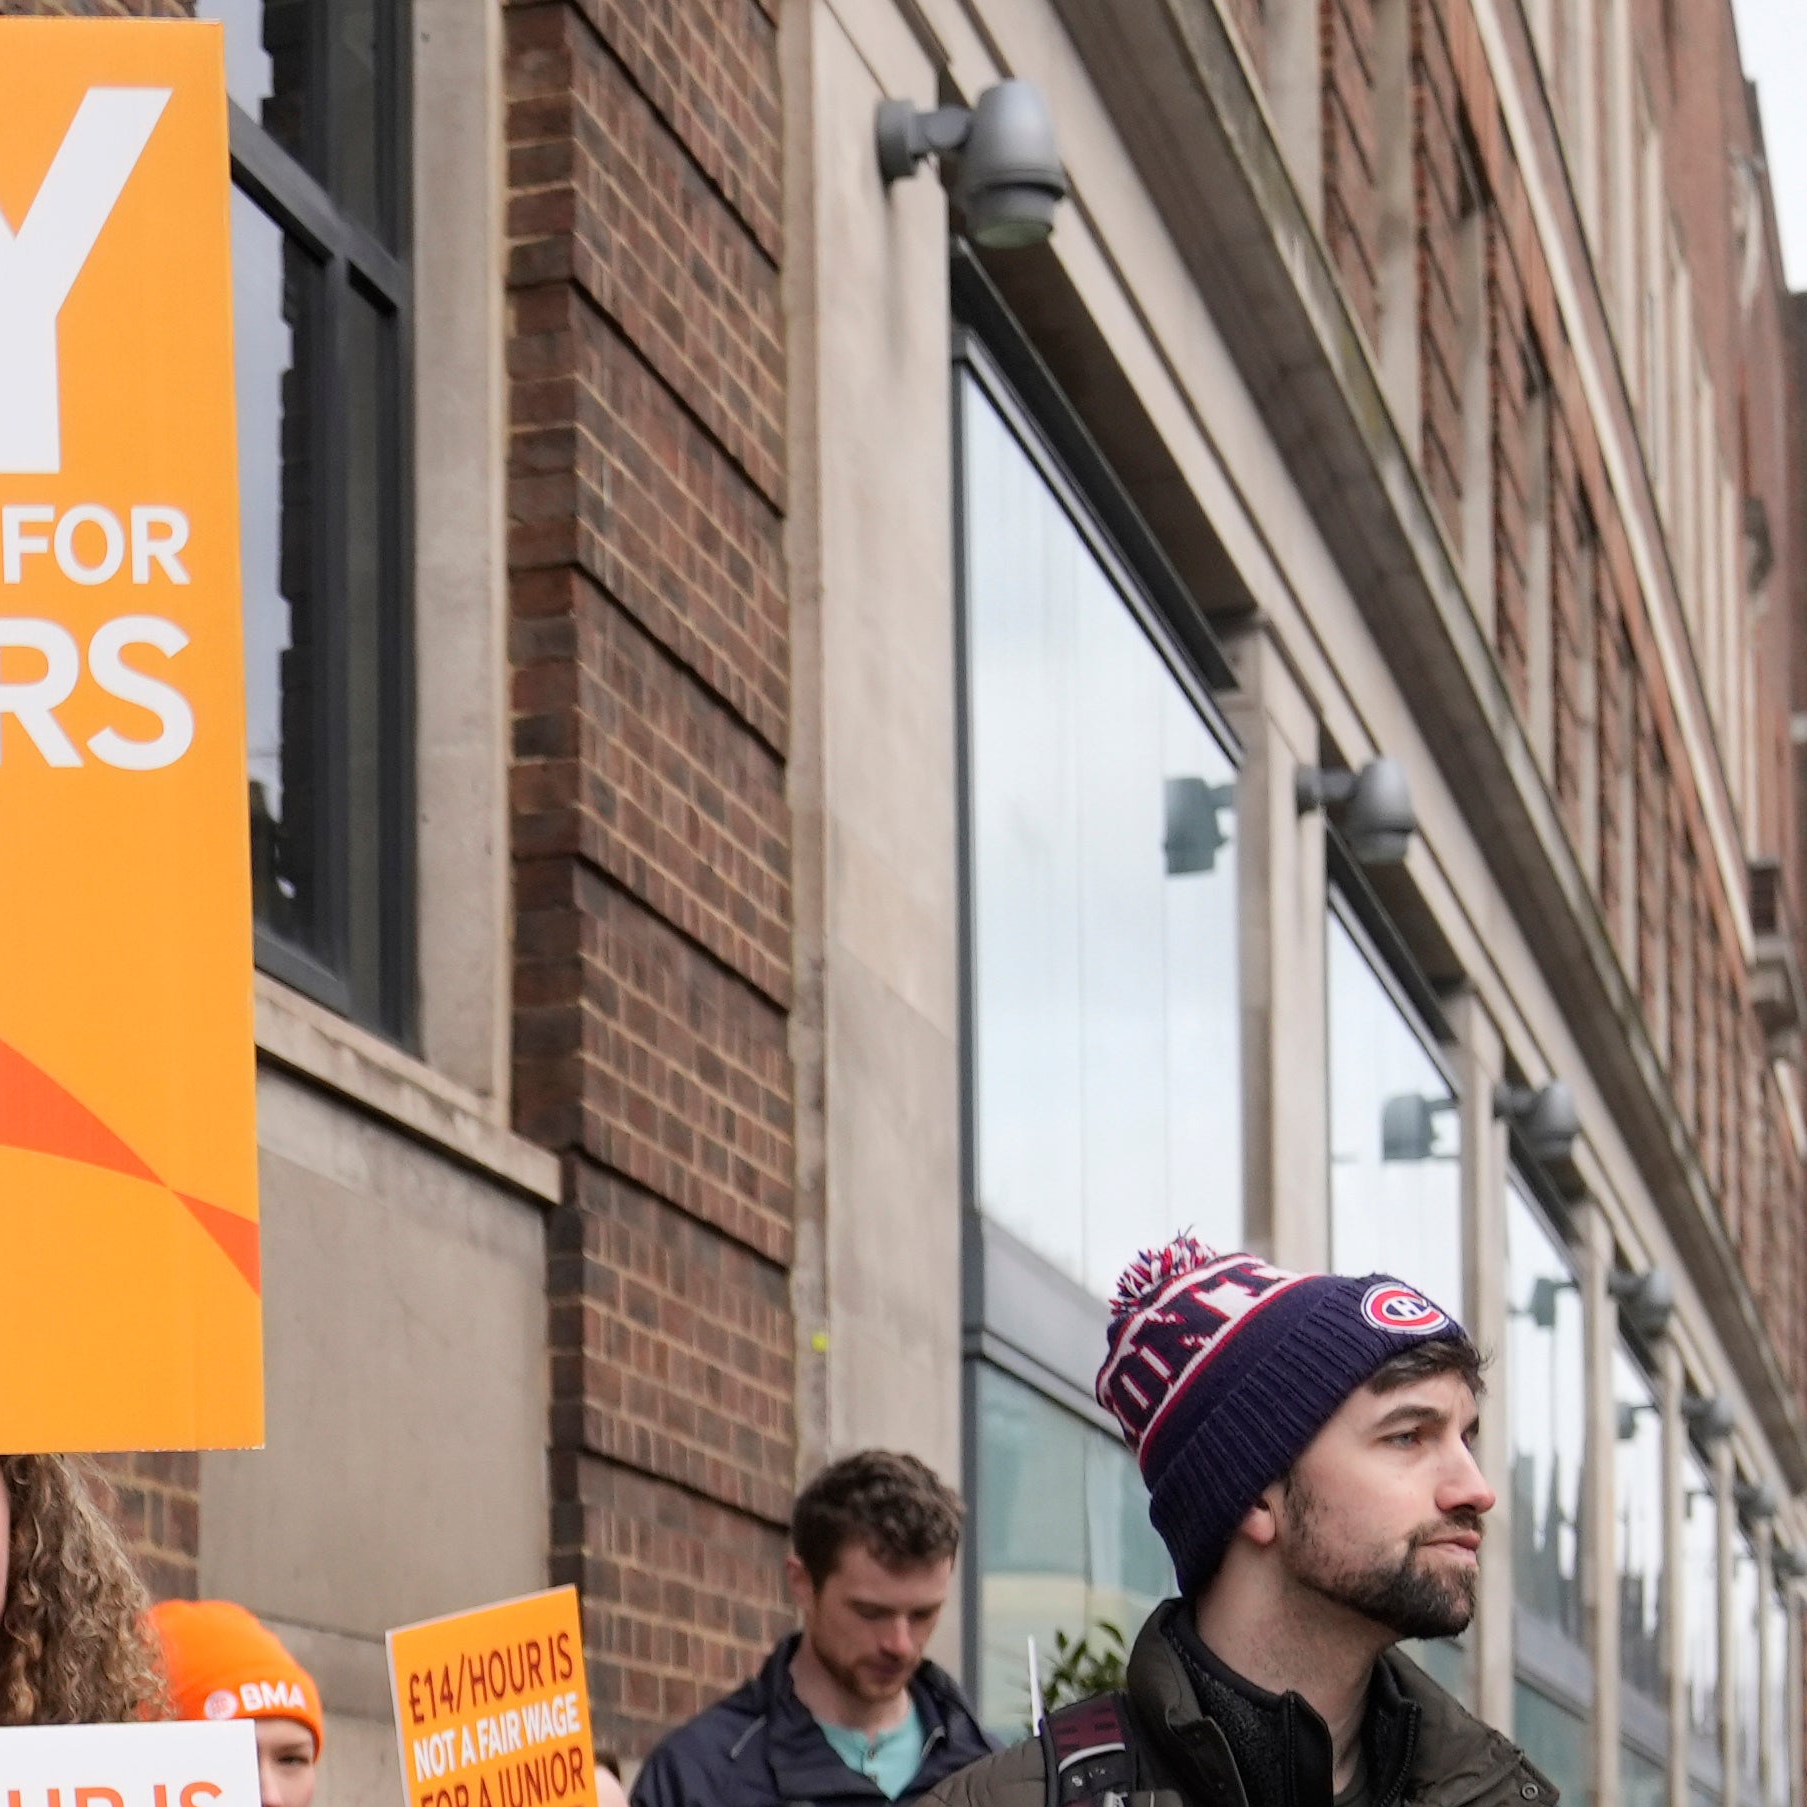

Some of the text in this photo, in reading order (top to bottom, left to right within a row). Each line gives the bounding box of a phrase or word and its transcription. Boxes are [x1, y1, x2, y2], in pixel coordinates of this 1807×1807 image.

[1, 504, 190, 586] FOR
[239, 1680, 306, 1711] BMA
[409, 1631, 574, 1726] £14/HOUR IS
[413, 1691, 582, 1783] NOT A FAIR WAGE
